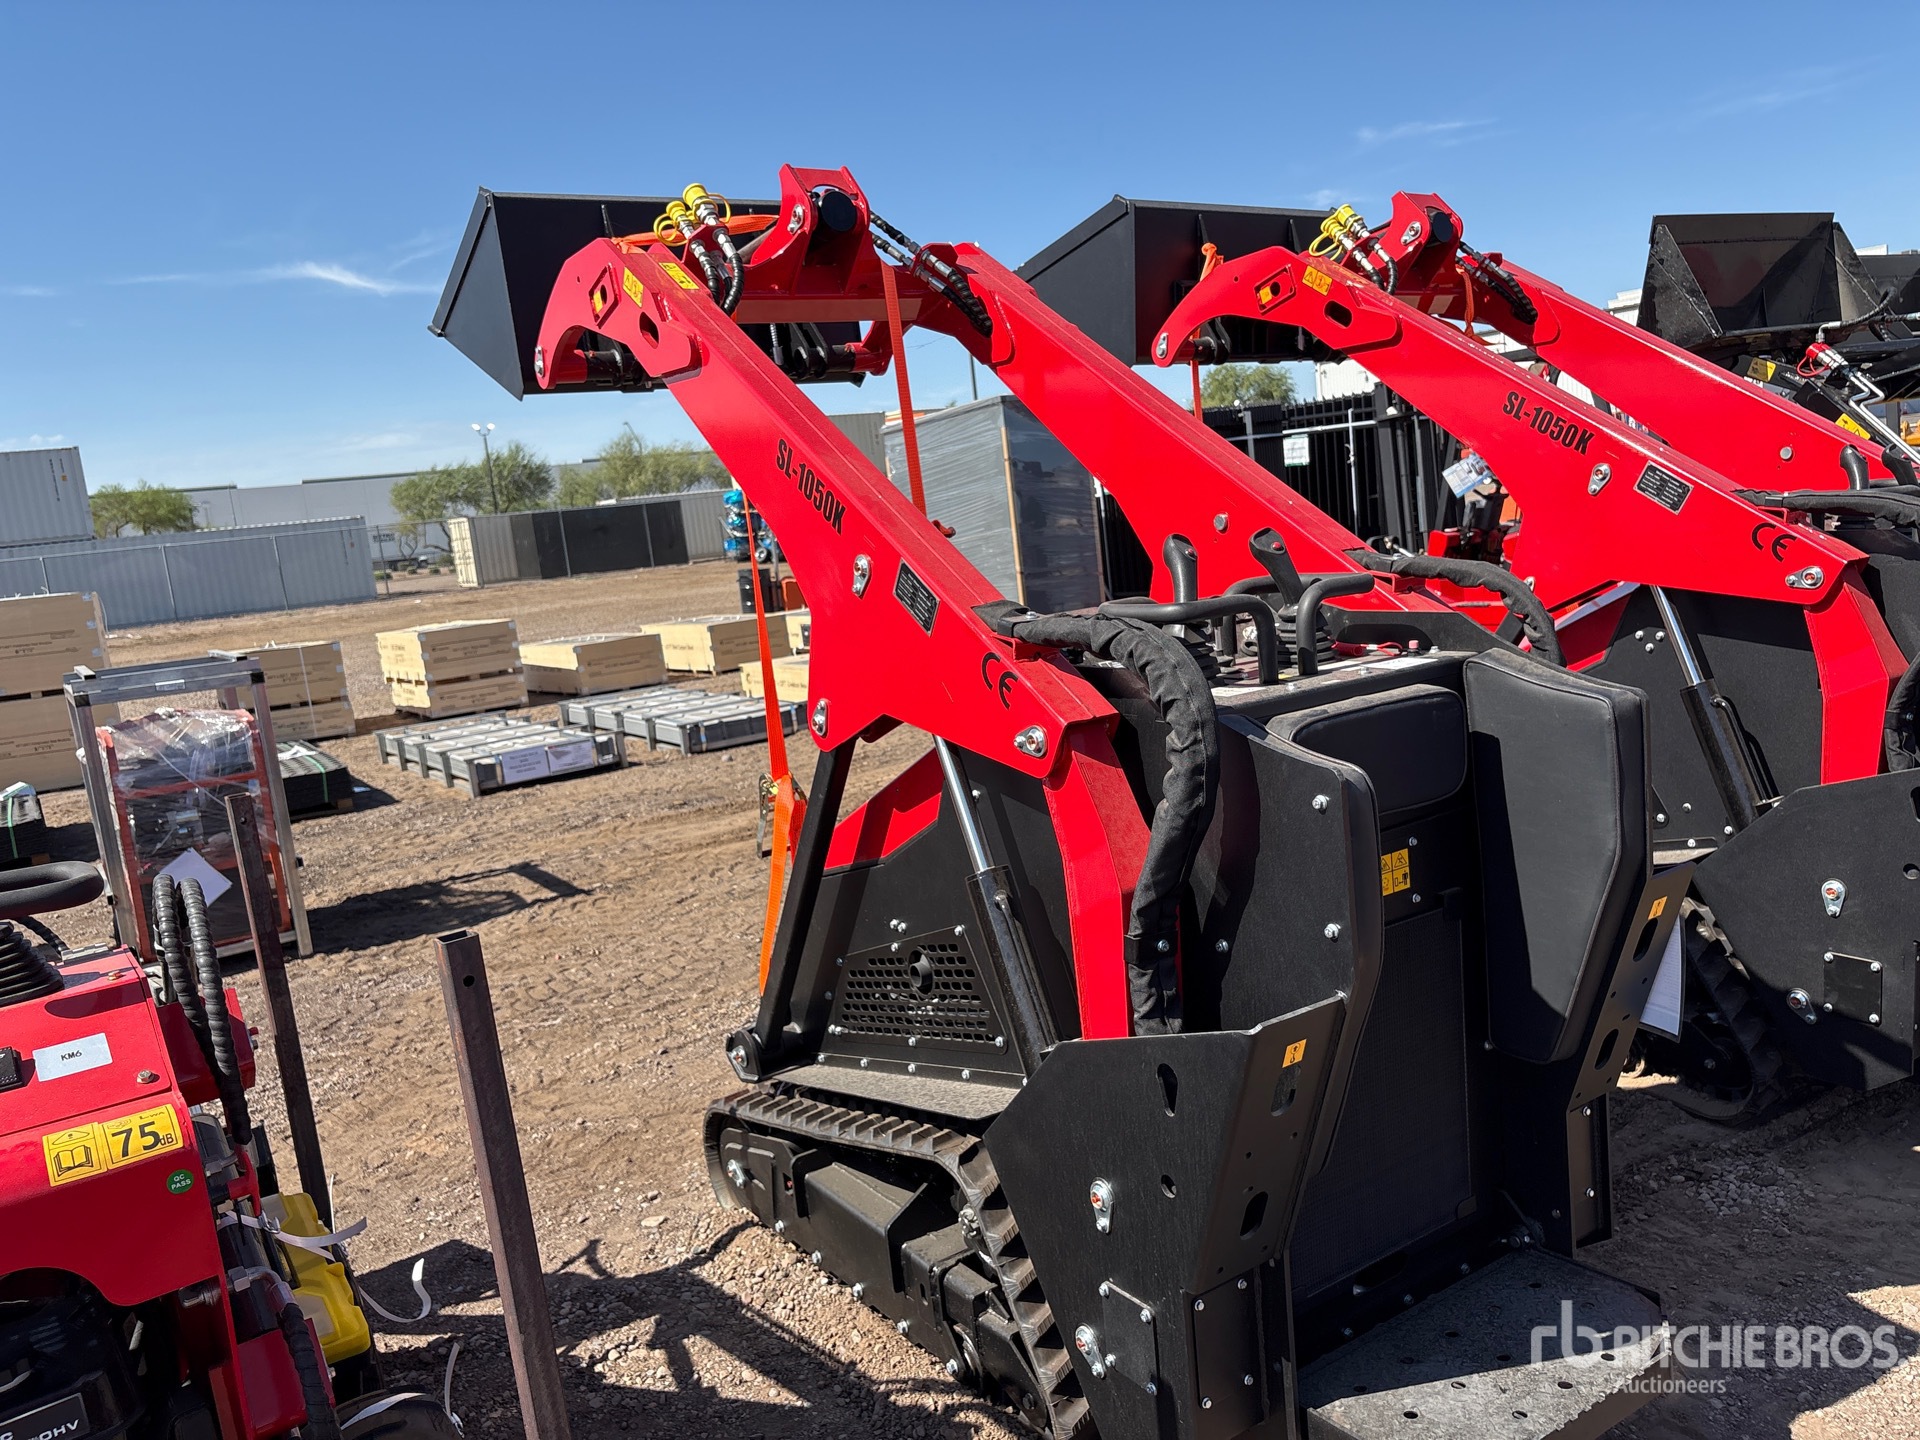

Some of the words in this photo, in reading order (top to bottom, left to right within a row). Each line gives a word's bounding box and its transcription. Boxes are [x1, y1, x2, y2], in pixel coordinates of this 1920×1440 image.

[1503, 391, 1595, 455] SL-1050K
[776, 438, 846, 535] SL-1050K
[1751, 522, 1797, 562] CE
[981, 651, 1018, 710] CE
[60, 1049, 82, 1061] KM6
[111, 1120, 161, 1158] 75
[171, 1178, 191, 1190] PASS
[173, 1173, 185, 1182] QC
